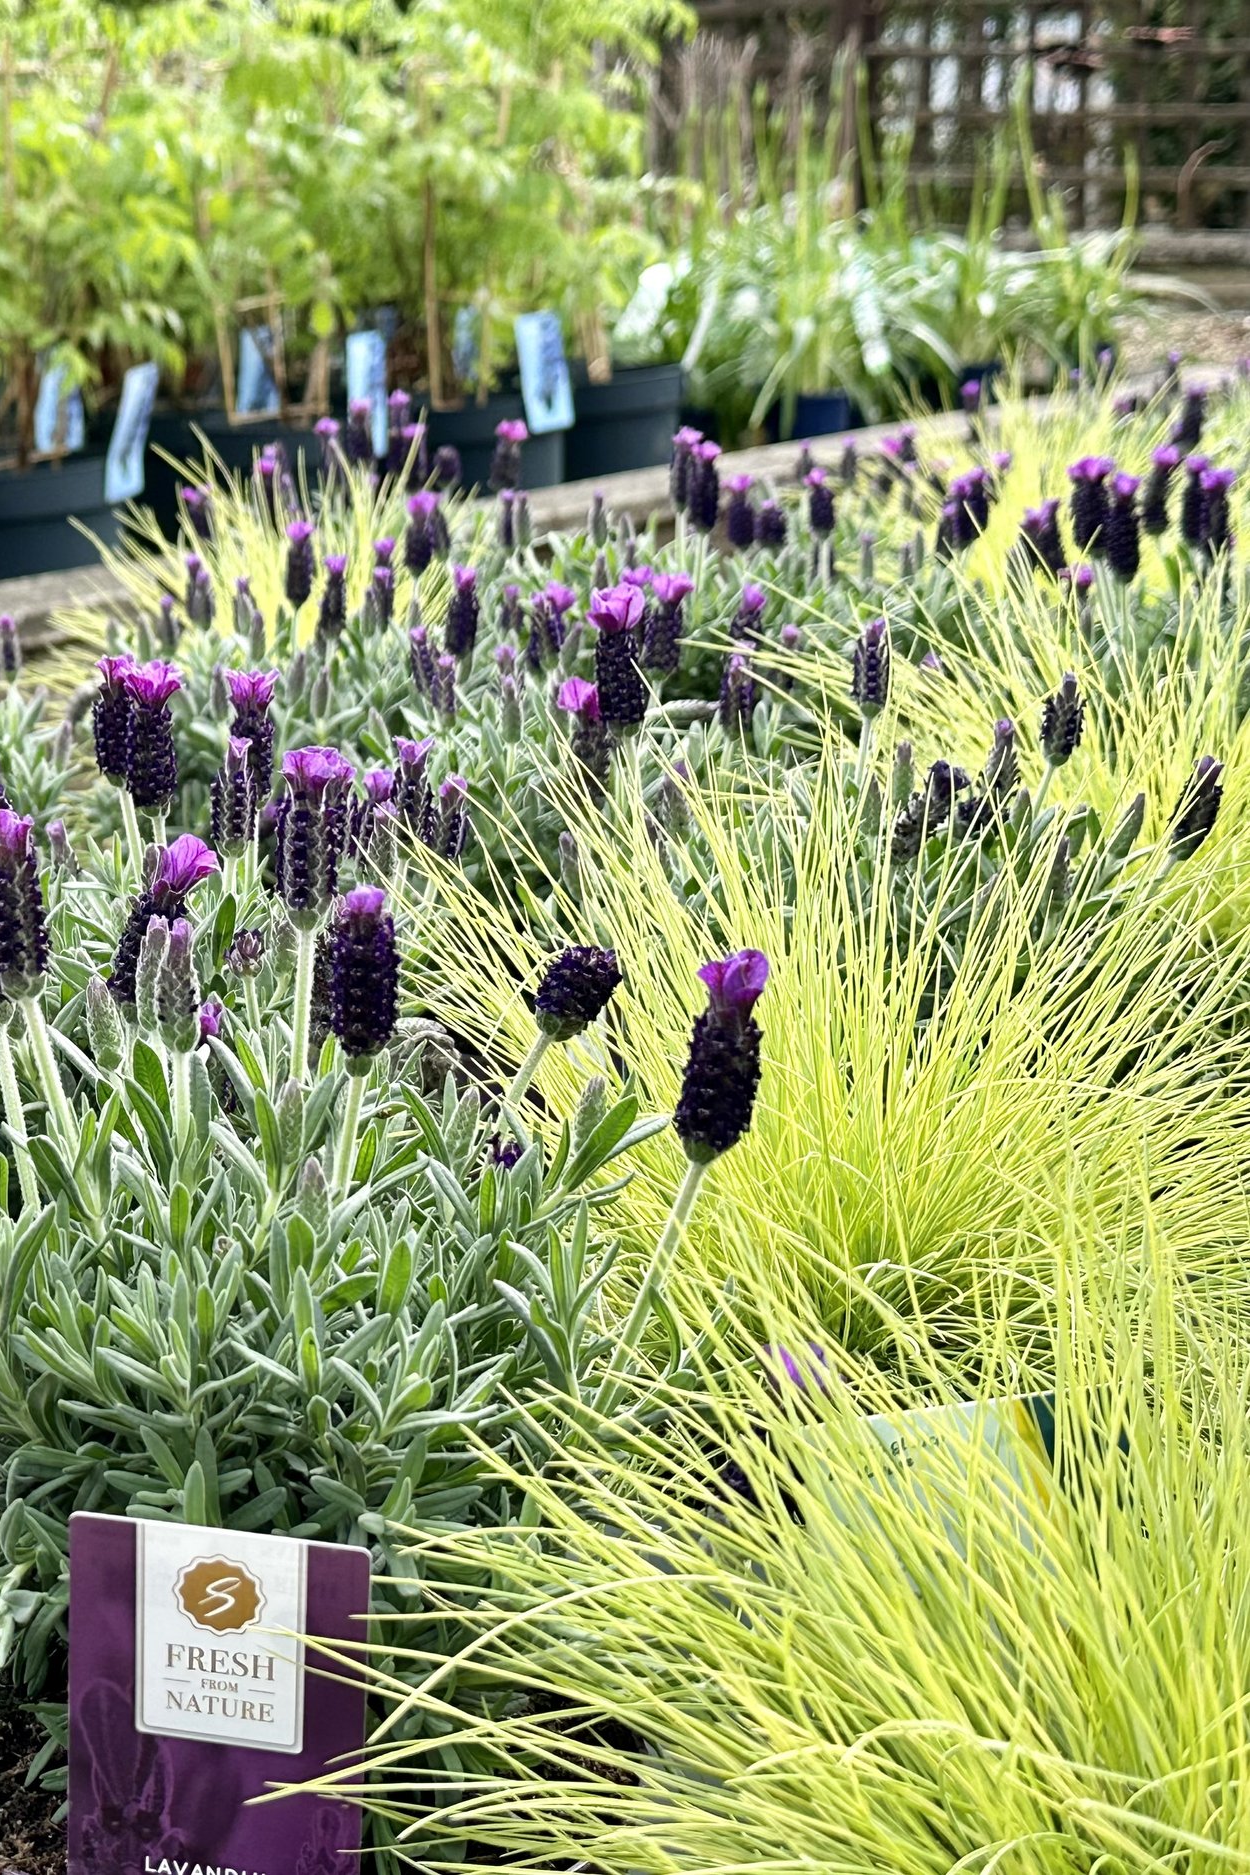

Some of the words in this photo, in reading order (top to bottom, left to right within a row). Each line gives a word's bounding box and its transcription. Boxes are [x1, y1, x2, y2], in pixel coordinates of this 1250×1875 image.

[166, 1642, 276, 1681] FRESH
[200, 1678, 239, 1694] FROM
[166, 1689, 275, 1724] NATURE
